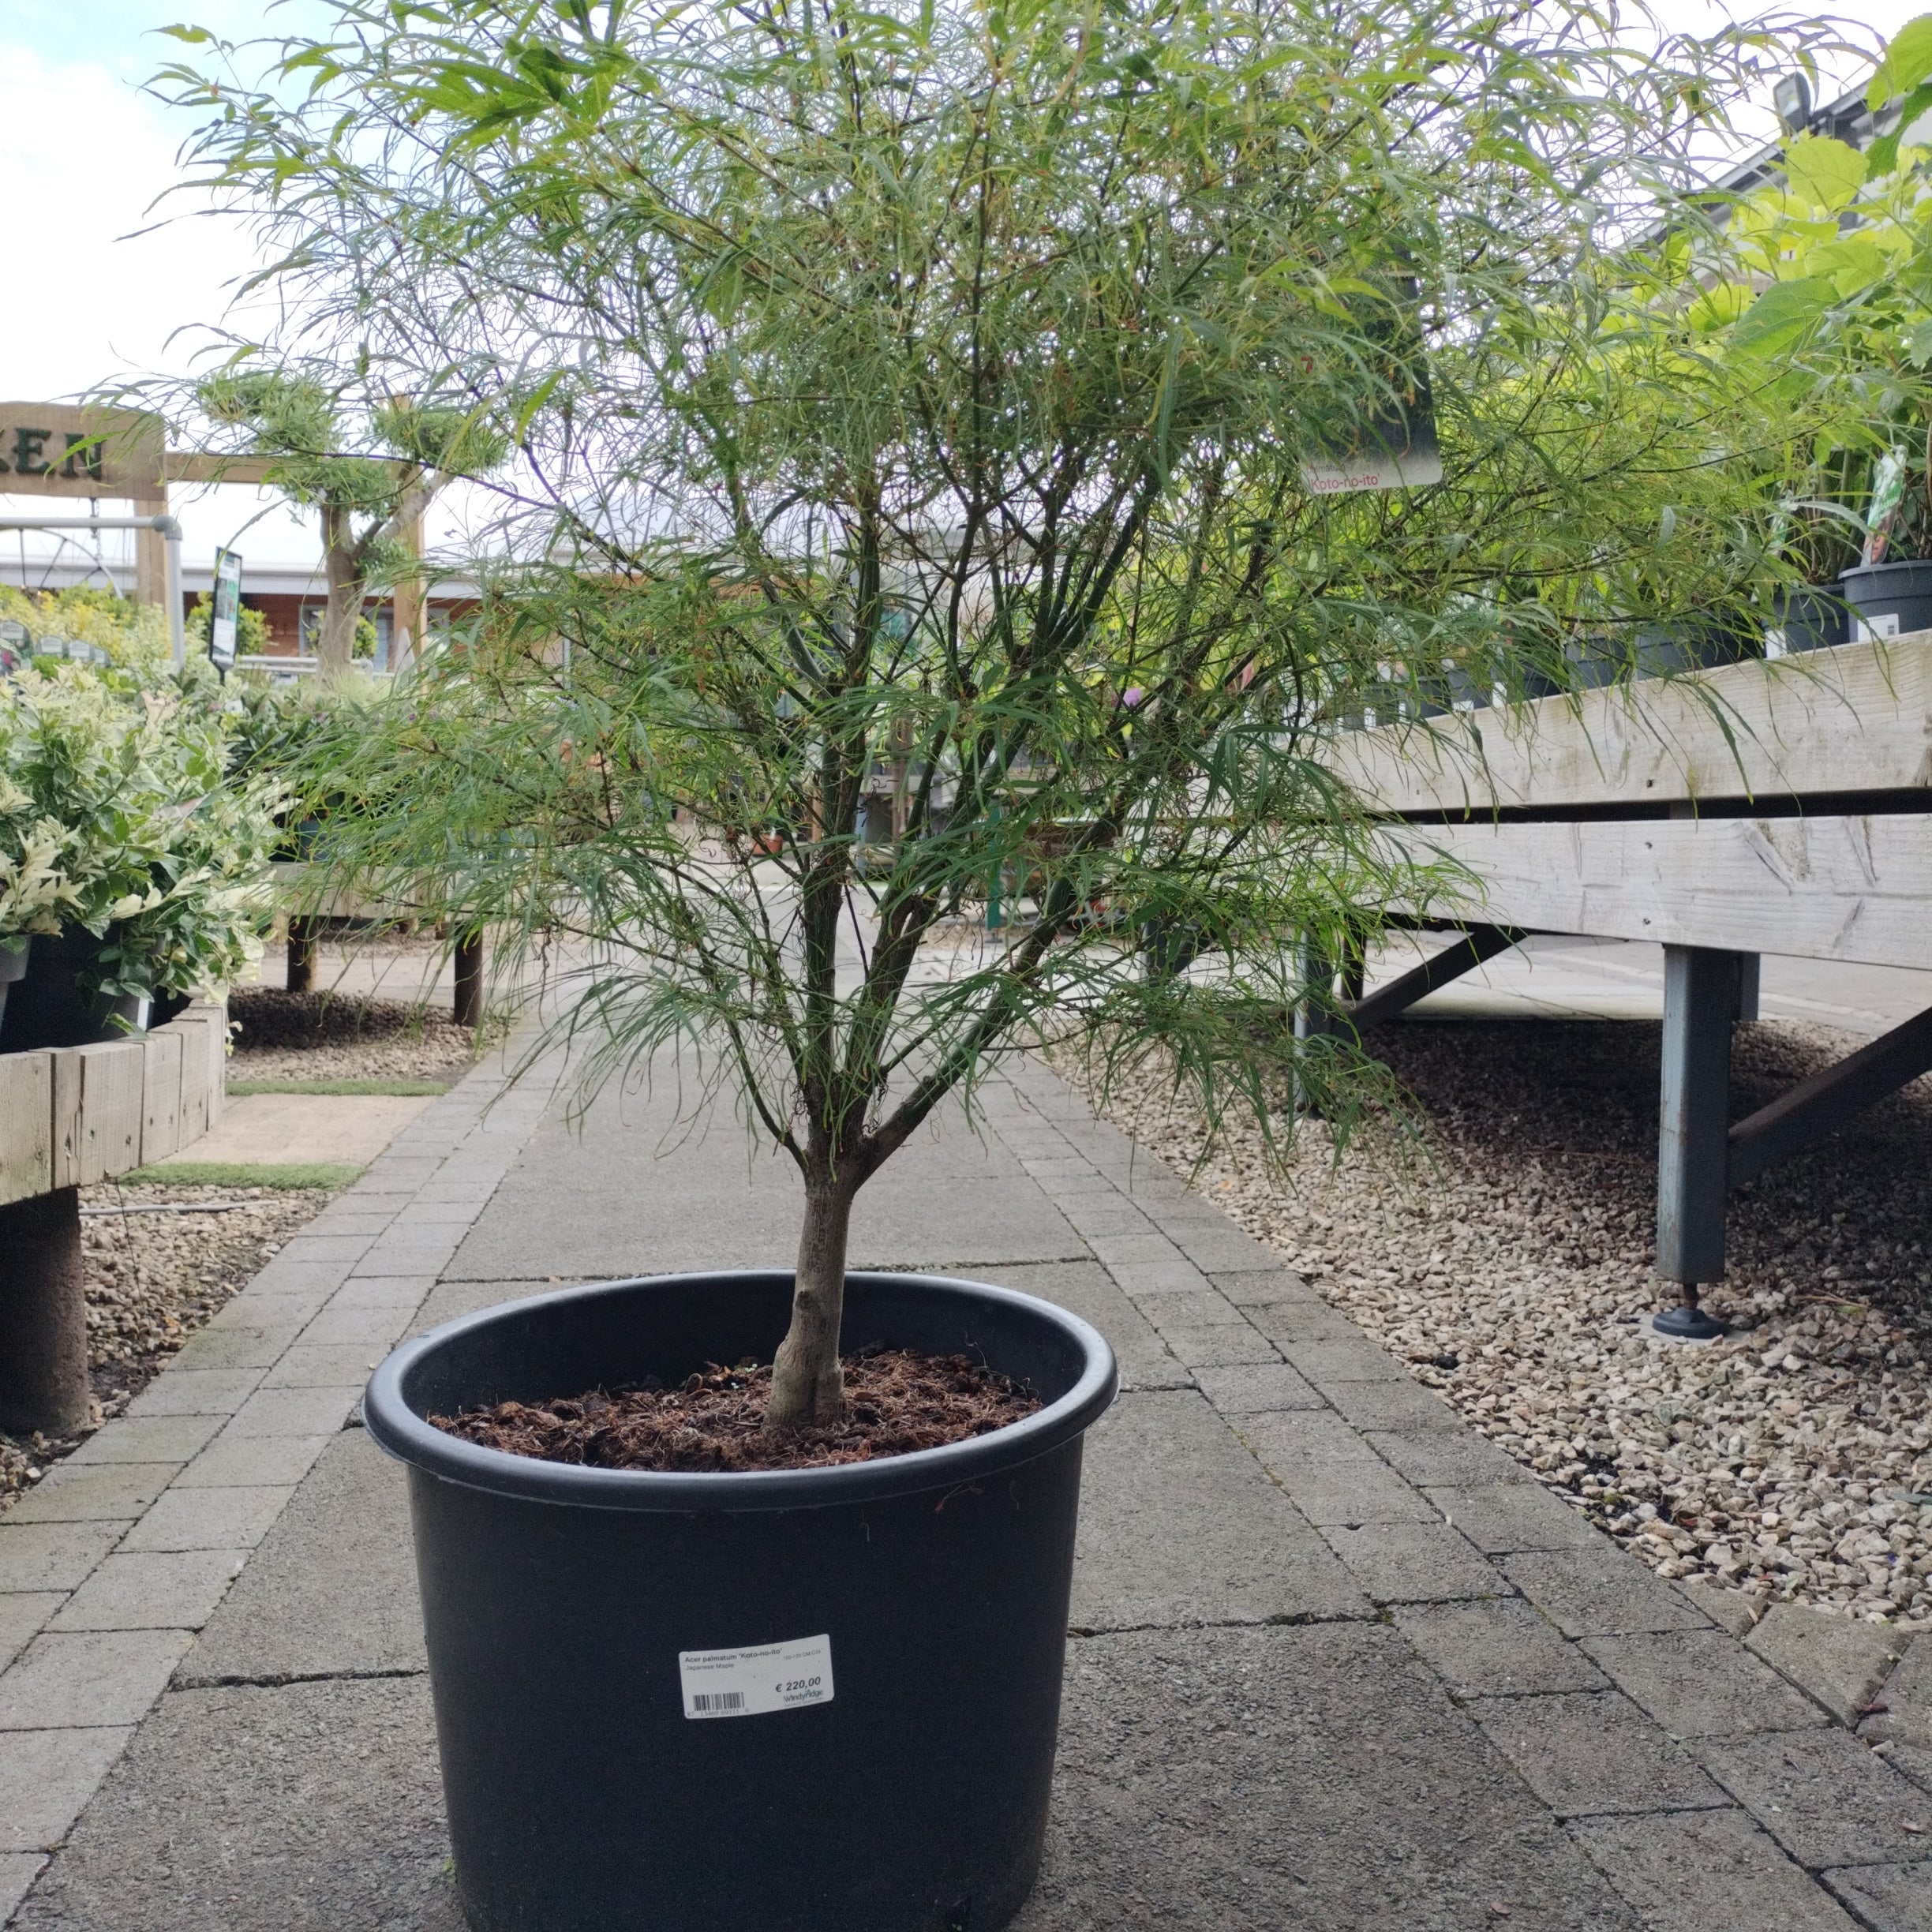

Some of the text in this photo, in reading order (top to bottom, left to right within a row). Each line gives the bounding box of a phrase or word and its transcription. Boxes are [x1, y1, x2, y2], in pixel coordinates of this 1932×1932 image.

[0, 427, 105, 480] EN
[702, 1654, 737, 1663] palmatum
[775, 1676, 821, 1693] € 220,00
